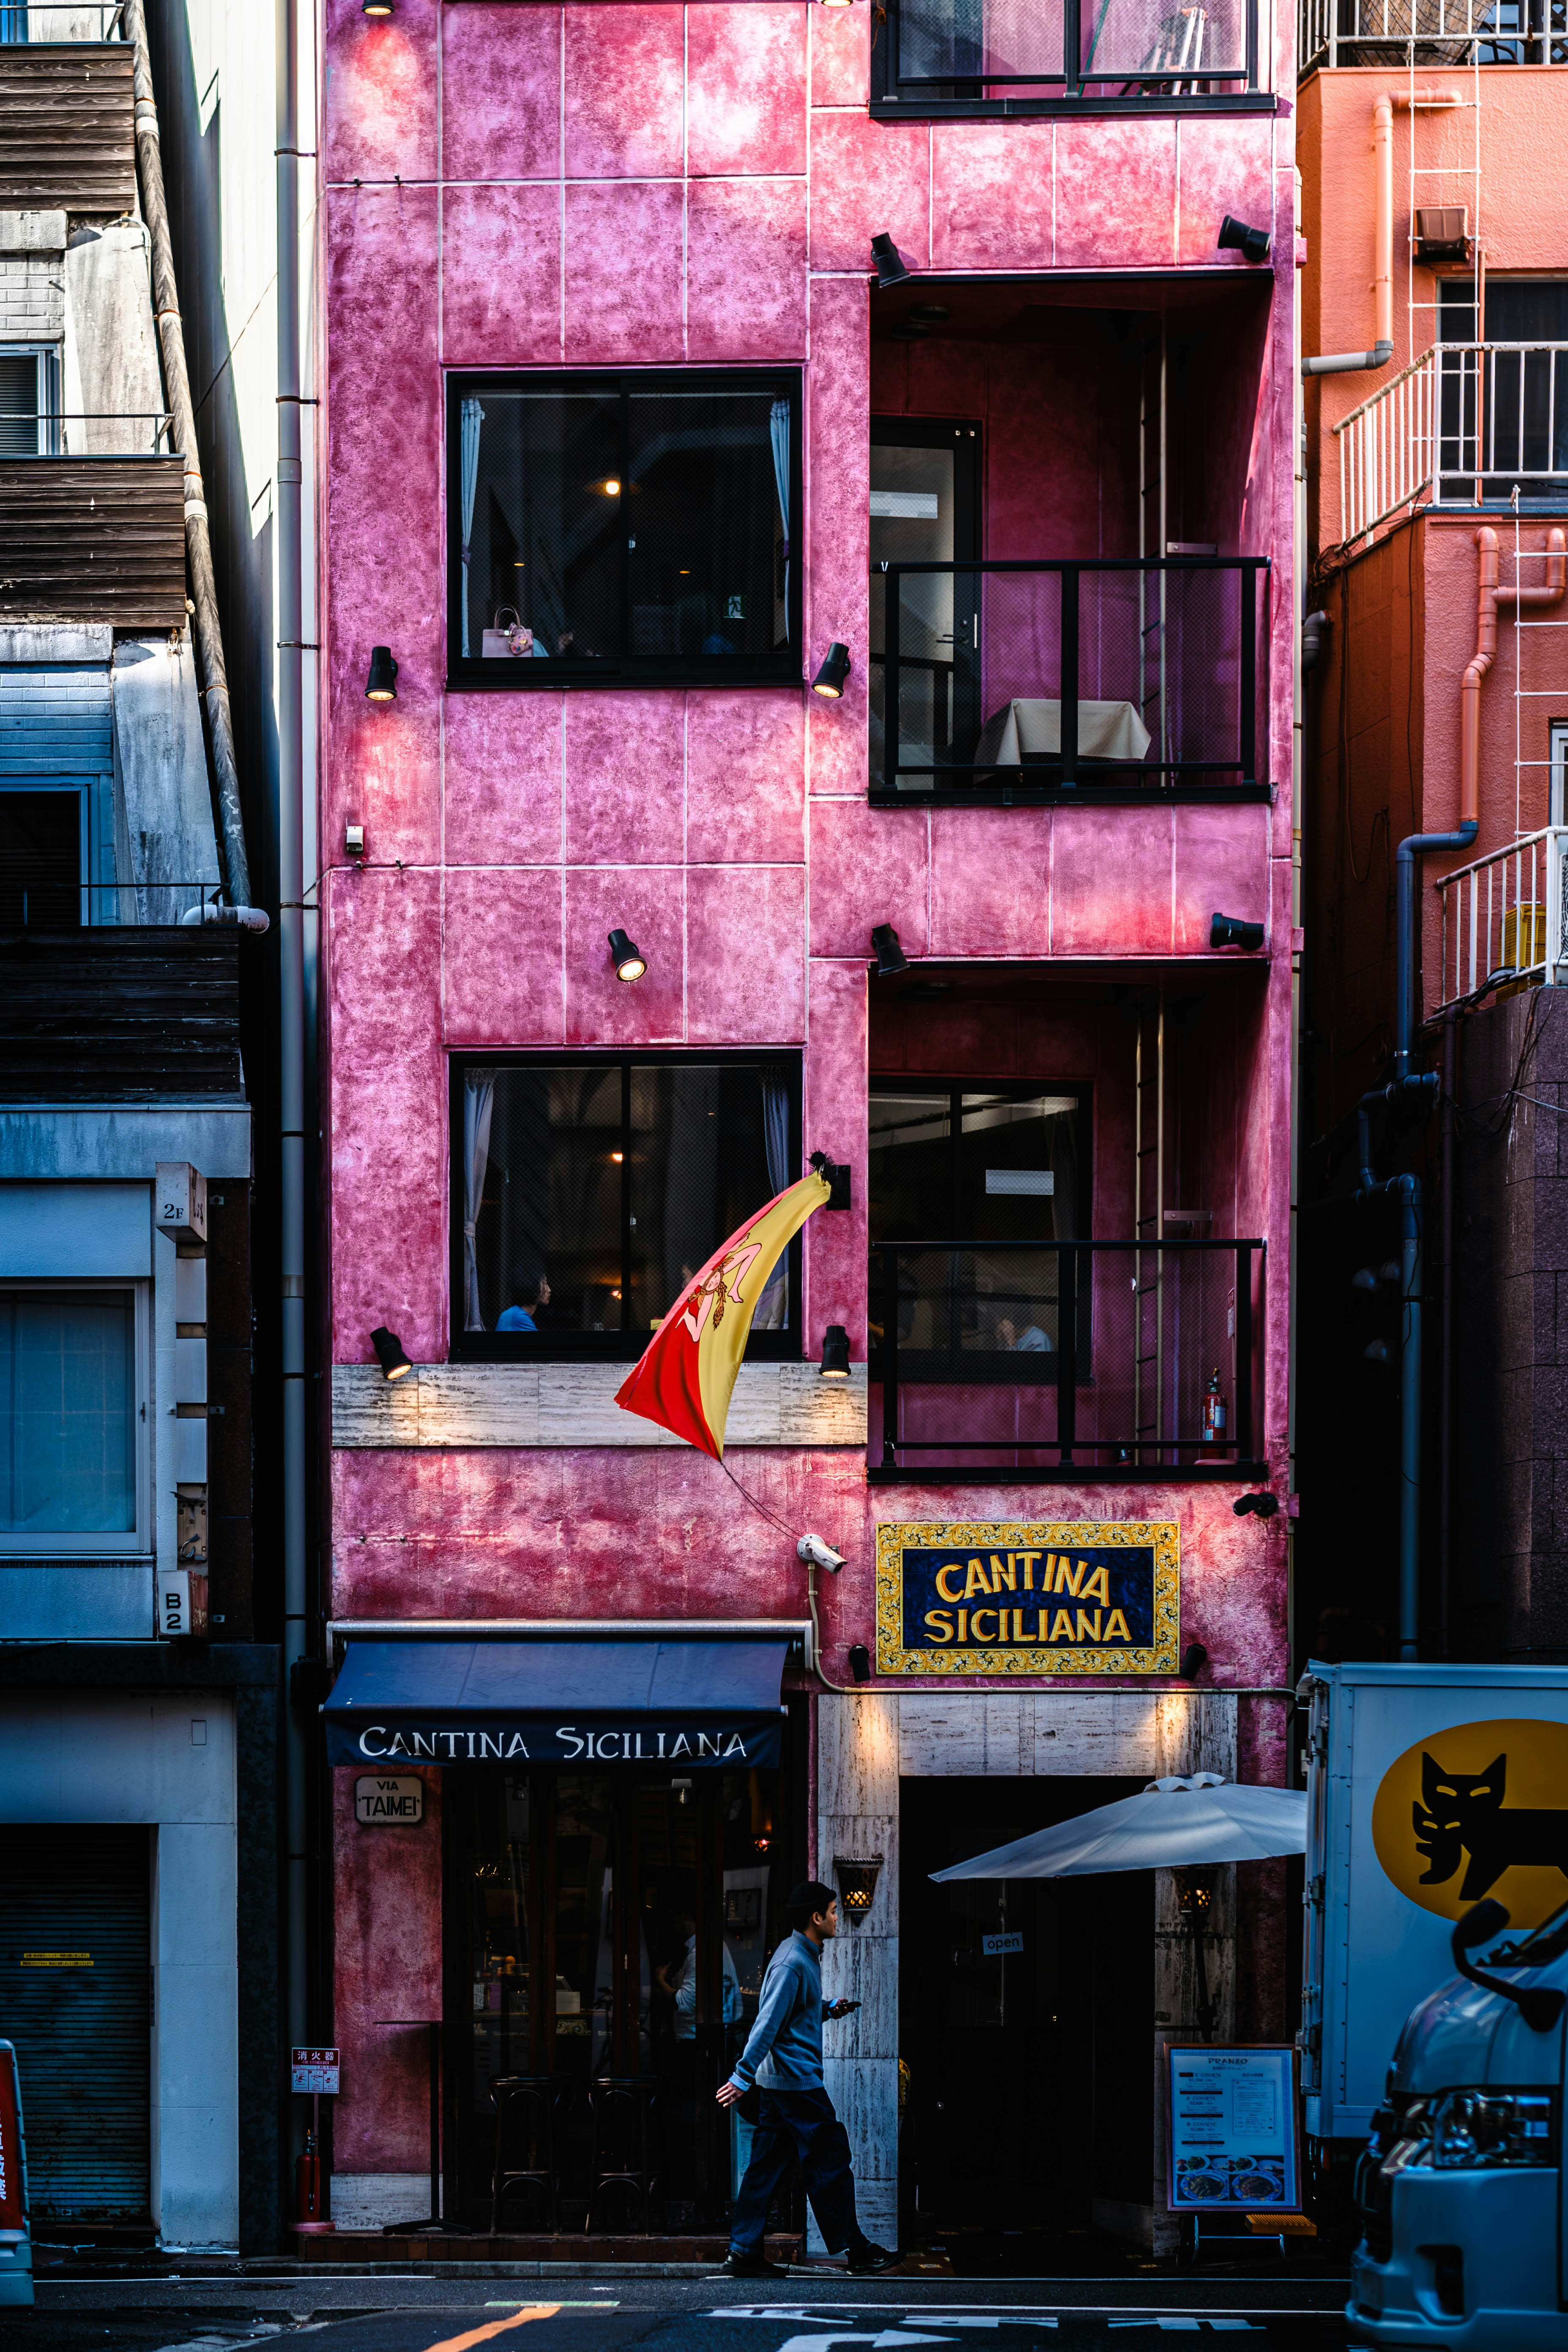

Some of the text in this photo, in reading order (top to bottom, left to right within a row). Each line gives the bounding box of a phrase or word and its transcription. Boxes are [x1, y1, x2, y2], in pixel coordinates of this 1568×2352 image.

[164, 1204, 184, 1219] 2F
[935, 1552, 1110, 1607] CANTINA
[924, 1609, 1133, 1642] SICILIANA
[359, 1727, 747, 1759] CANTINA SICILIANA
[377, 1781, 398, 1790] VIA
[362, 1796, 416, 1816] TAIMEI
[988, 1938, 1019, 1952] open
[298, 2051, 334, 2061] 消火器
[1209, 2058, 1247, 2066] PRANZO
